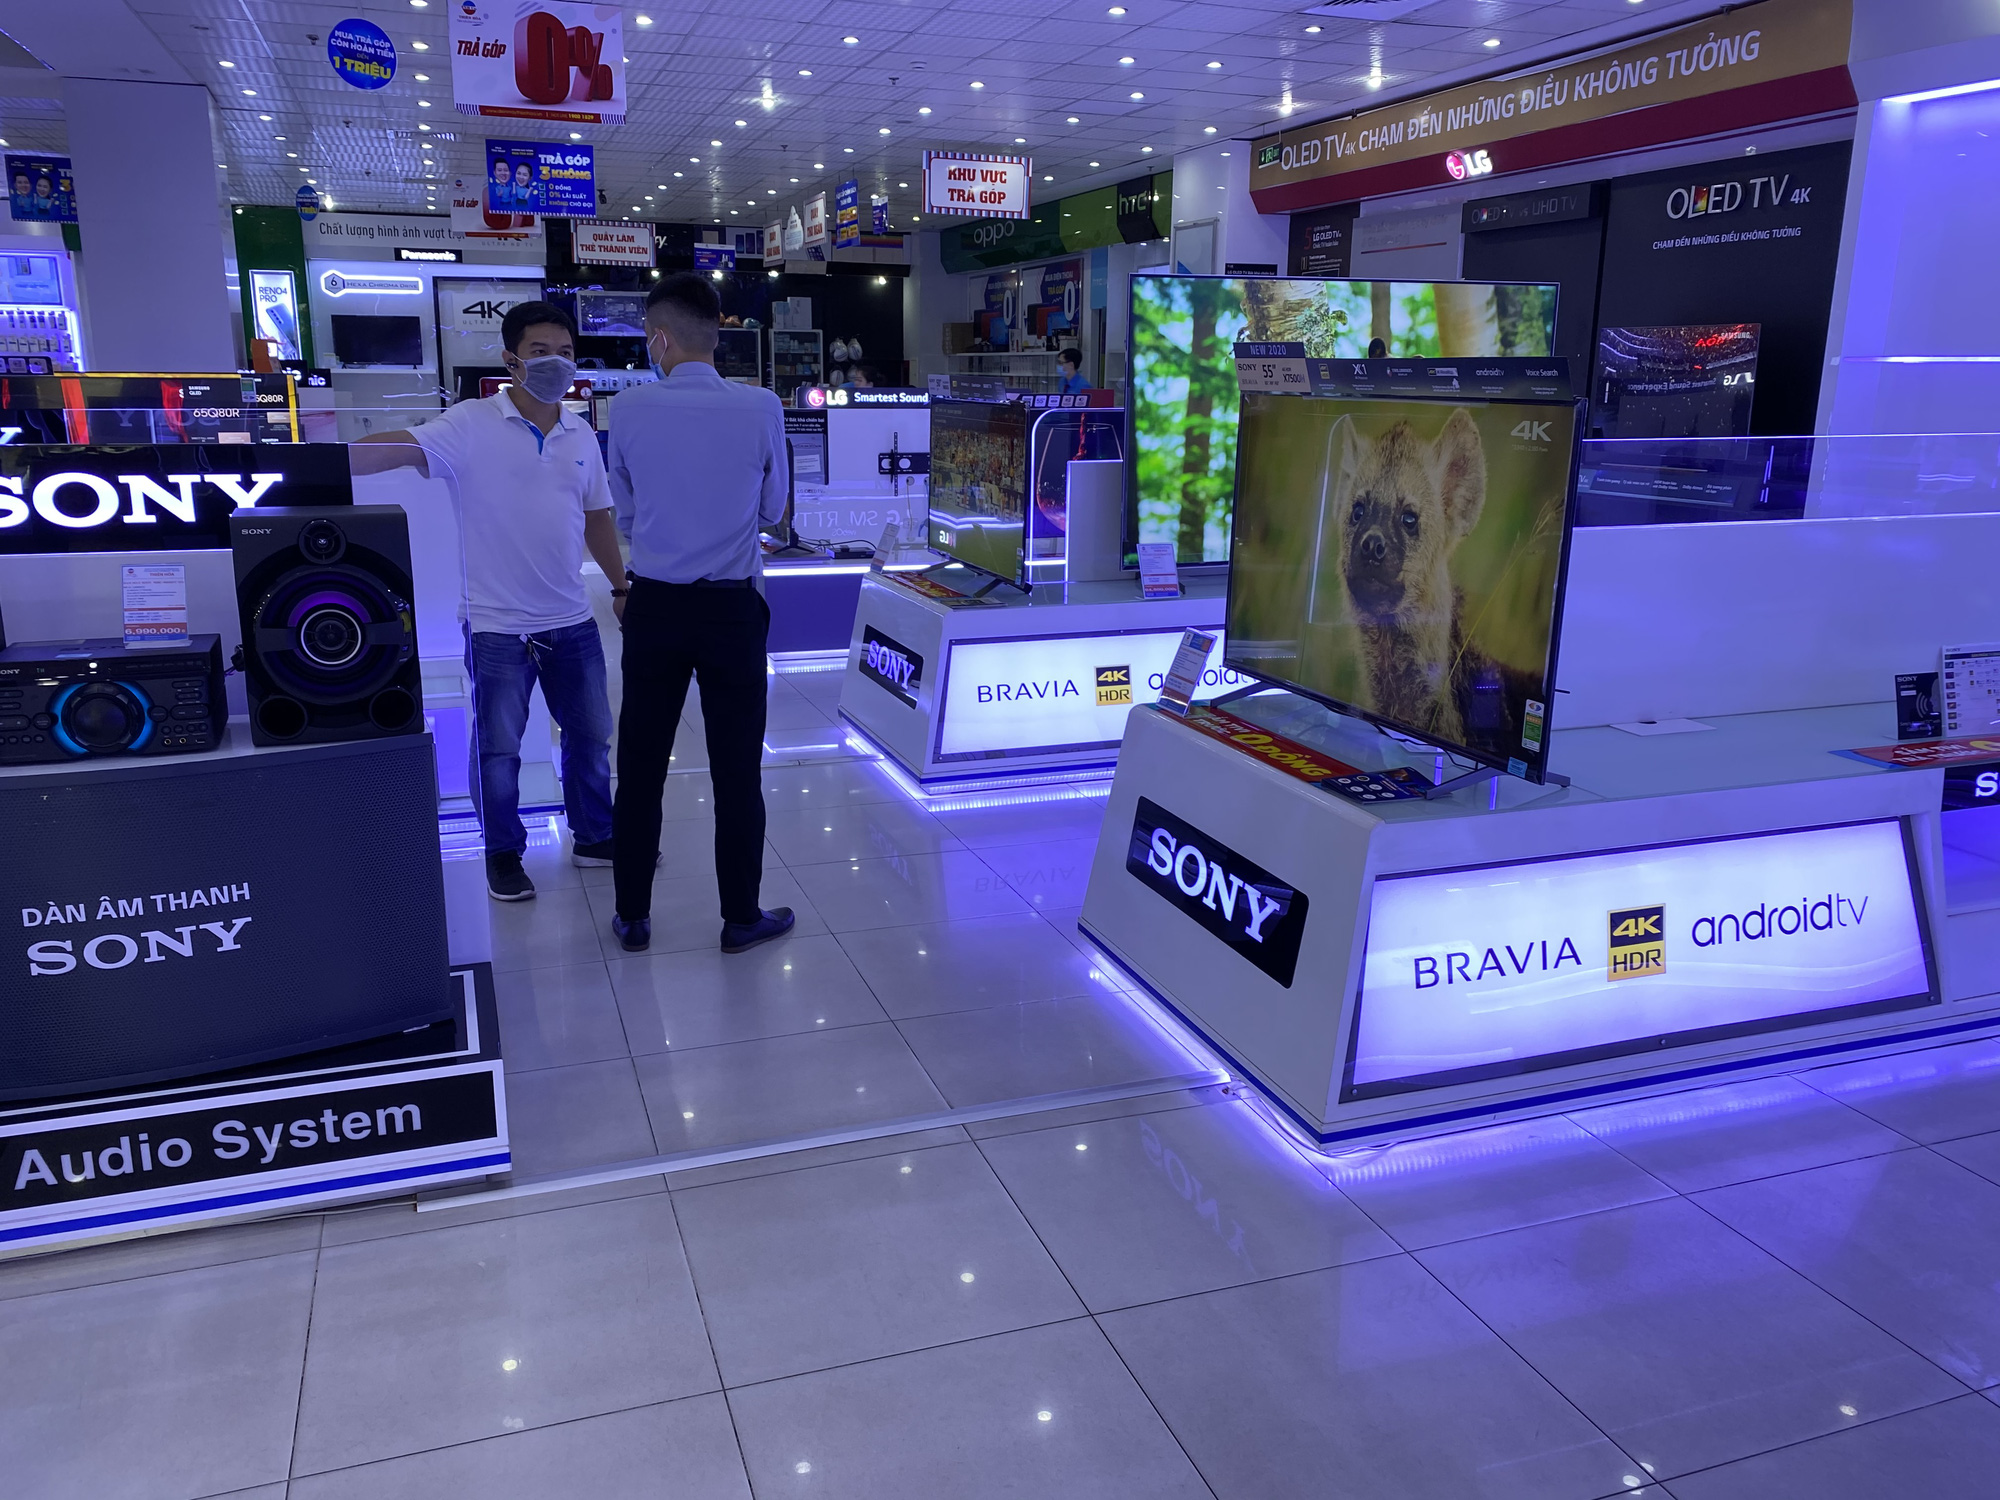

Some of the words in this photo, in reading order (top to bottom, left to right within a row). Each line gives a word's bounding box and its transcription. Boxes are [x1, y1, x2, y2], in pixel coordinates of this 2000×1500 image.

[331, 38, 349, 48] CÒN
[351, 43, 374, 54] HOÀN
[335, 30, 354, 40] MUA
[355, 35, 372, 44] TRẢ
[374, 39, 390, 48] GÓP
[457, 36, 480, 57] TRẢ
[482, 39, 506, 58] GÓP
[514, 11, 613, 105] 0%
[333, 56, 340, 69] 1
[344, 58, 391, 79] TRIỆU
[1281, 139, 1321, 171] OLED
[1324, 132, 1347, 161] TV
[1359, 122, 1403, 151] CHẠM
[1407, 109, 1442, 141] ĐẾN
[1446, 94, 1515, 132] NHỮNG
[1519, 73, 1568, 115] ĐIỀU
[1573, 60, 1659, 102] KHÔNG
[1666, 30, 1761, 79] TƯỞNG
[538, 152, 564, 165] TRẢ
[565, 154, 590, 166] GÓP
[1464, 149, 1493, 176] LG
[539, 166, 550, 180] 3
[551, 168, 592, 180] KHÔNG
[948, 168, 976, 181] KHU
[980, 169, 1007, 185] VỰC
[948, 186, 975, 203] TRẢ
[979, 188, 1006, 204] GÓP
[1667, 181, 1743, 219] OLED
[1750, 174, 1789, 209] TV
[1791, 187, 1812, 204] 4K
[1532, 200, 1558, 215] UHD
[320, 222, 342, 235] Chất
[346, 224, 374, 239] lượng
[378, 225, 399, 237] hình
[402, 226, 420, 238] ảnh
[423, 228, 445, 241] vượt
[616, 233, 635, 243] LÀM
[1652, 239, 1674, 250] CHẠM
[1675, 236, 1690, 247] ĐẾN
[1692, 233, 1719, 245] NHỮNG
[1721, 230, 1739, 243] ĐIỀU
[1741, 229, 1770, 241] KHÔNG
[1772, 225, 1801, 238] TƯỞNG
[400, 249, 456, 261] Panasonic
[599, 244, 626, 254] THÀNH
[628, 246, 648, 254] VIÊN
[259, 286, 288, 295] RENO4
[330, 277, 338, 286] 6
[462, 301, 506, 319] 4K
[1250, 345, 1266, 355] NEW
[1268, 344, 1287, 355] 2020
[1541, 369, 1558, 377] Search
[255, 394, 284, 402] 5Q80R
[826, 390, 848, 405] LG
[854, 392, 898, 403] Smartest
[899, 392, 929, 402] Sound
[193, 408, 240, 418] 65Q80R
[1510, 420, 1552, 442] 4K
[867, 640, 915, 690] SONY
[1098, 669, 1128, 683] 4K
[977, 679, 1079, 703] BRAVIA
[1098, 688, 1131, 702] HDR
[1256, 744, 1331, 777] ĐỒNG
[1147, 827, 1280, 943] SONY
[22, 901, 86, 927] DÀN
[96, 895, 144, 920] ÂM
[150, 882, 251, 913] THANH
[1612, 914, 1661, 937] 4K
[26, 917, 252, 976] SONY
[1414, 936, 1582, 989] BRAVIA
[1612, 948, 1661, 973] HDR
[14, 1132, 192, 1191] Audio
[211, 1104, 422, 1165] System
